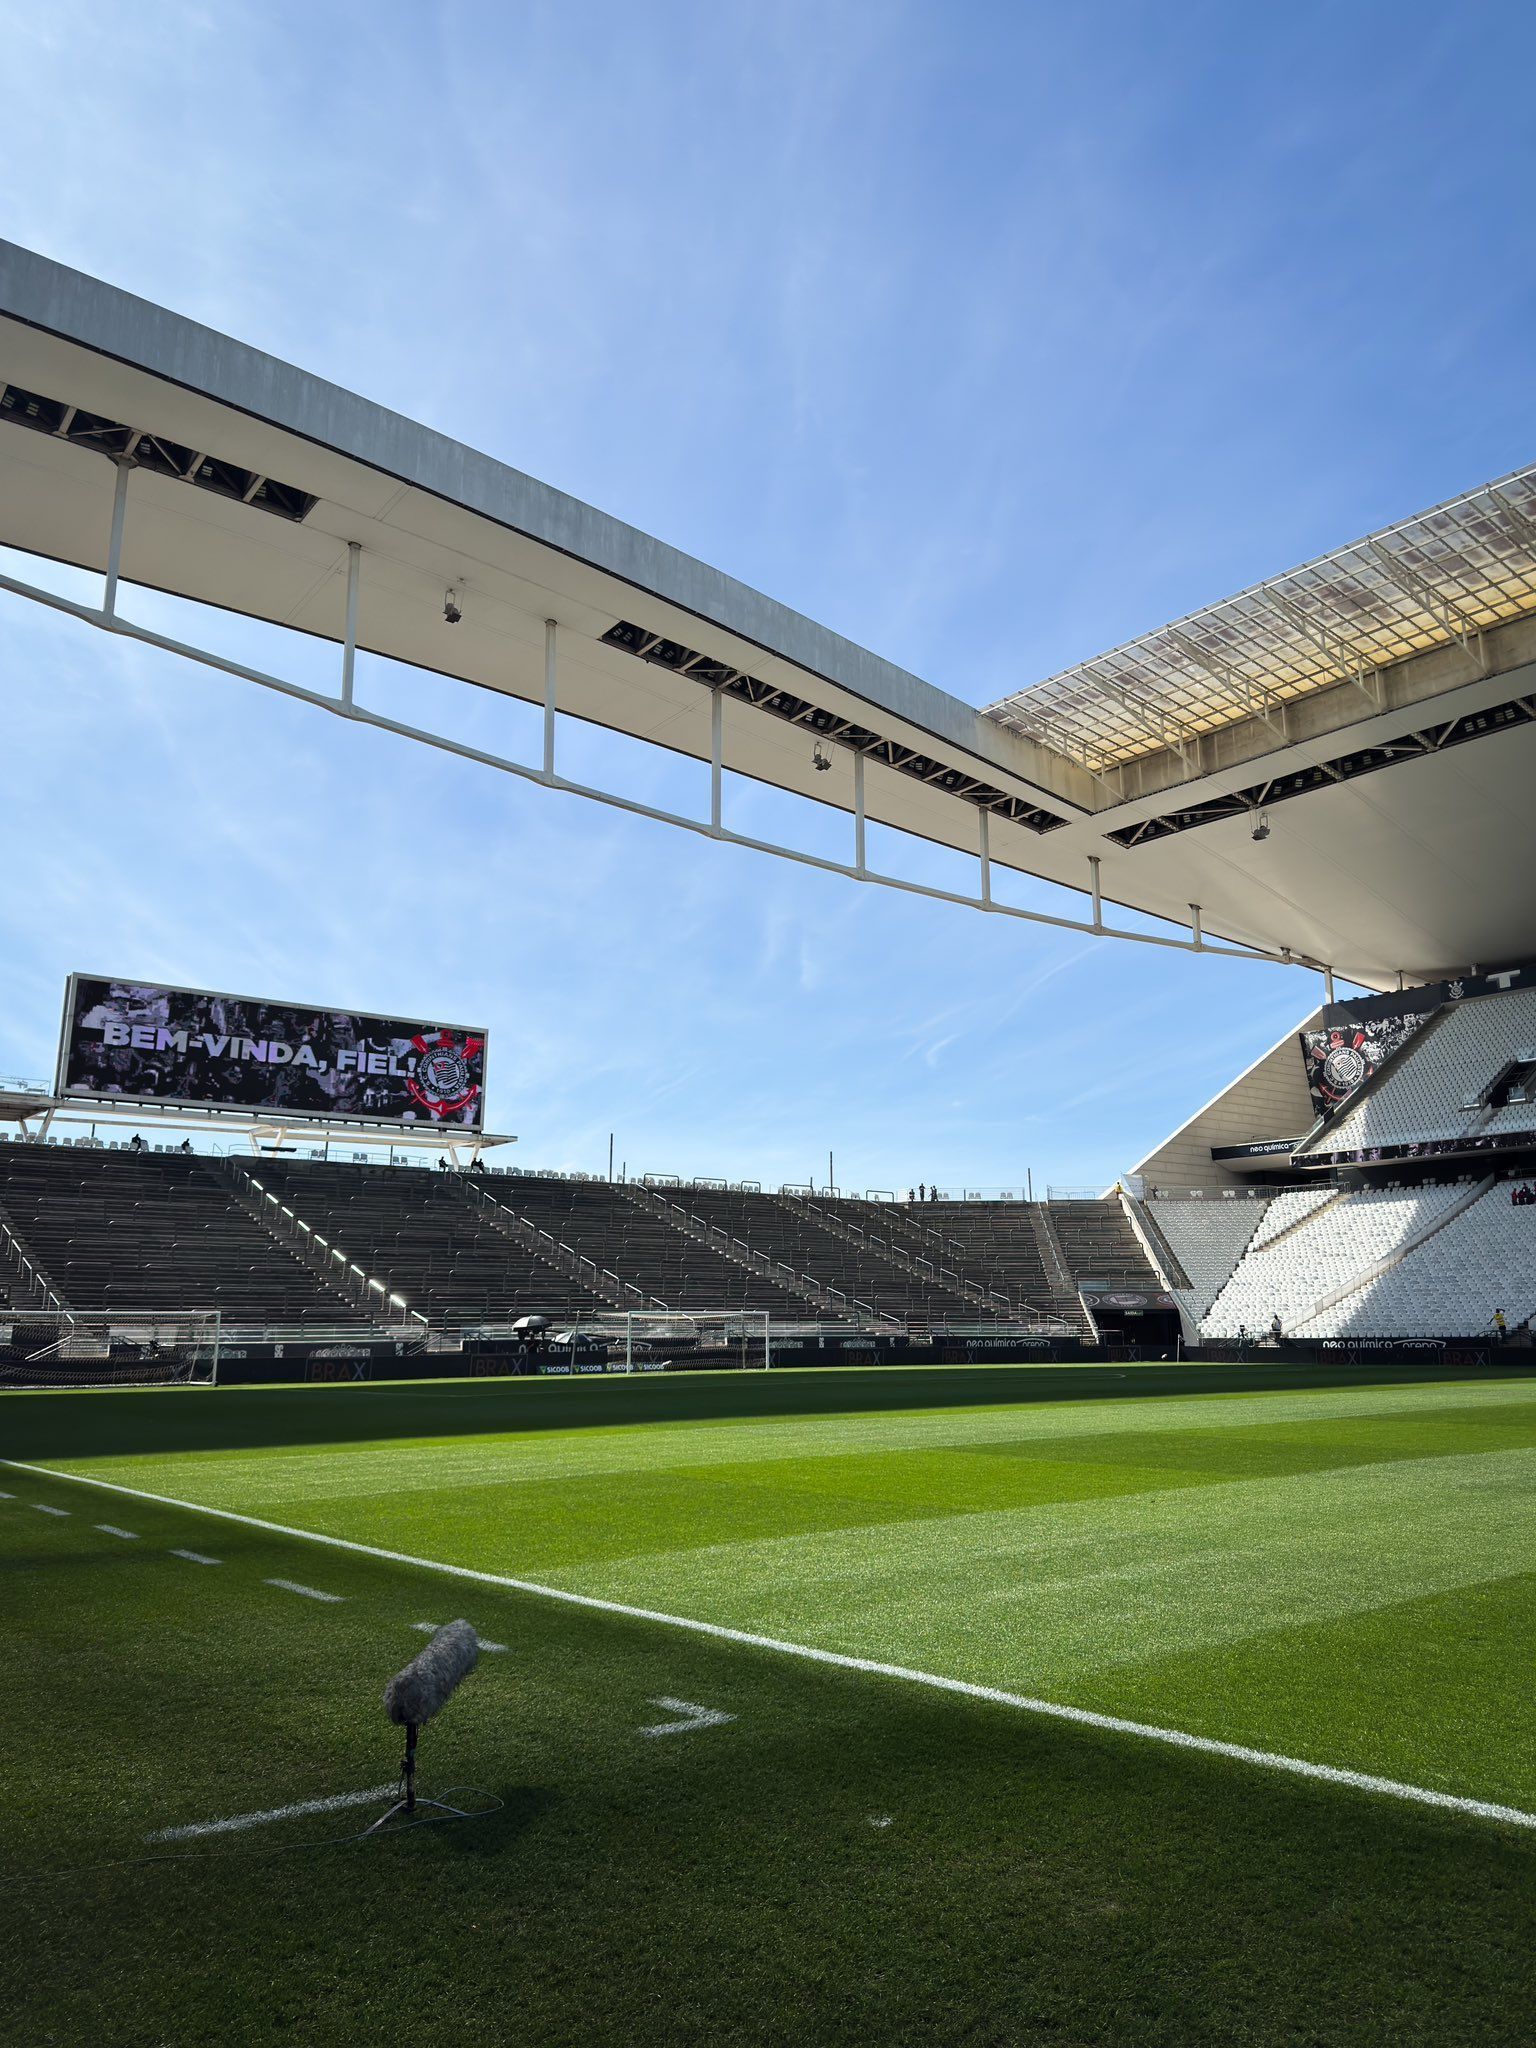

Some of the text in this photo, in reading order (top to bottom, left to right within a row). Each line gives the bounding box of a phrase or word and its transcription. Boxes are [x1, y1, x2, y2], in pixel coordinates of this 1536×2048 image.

[103, 1021, 417, 1078] BEM-VINDA, FIEL!
[1322, 1340, 1346, 1349] neo
[312, 1361, 366, 1382] BRAX
